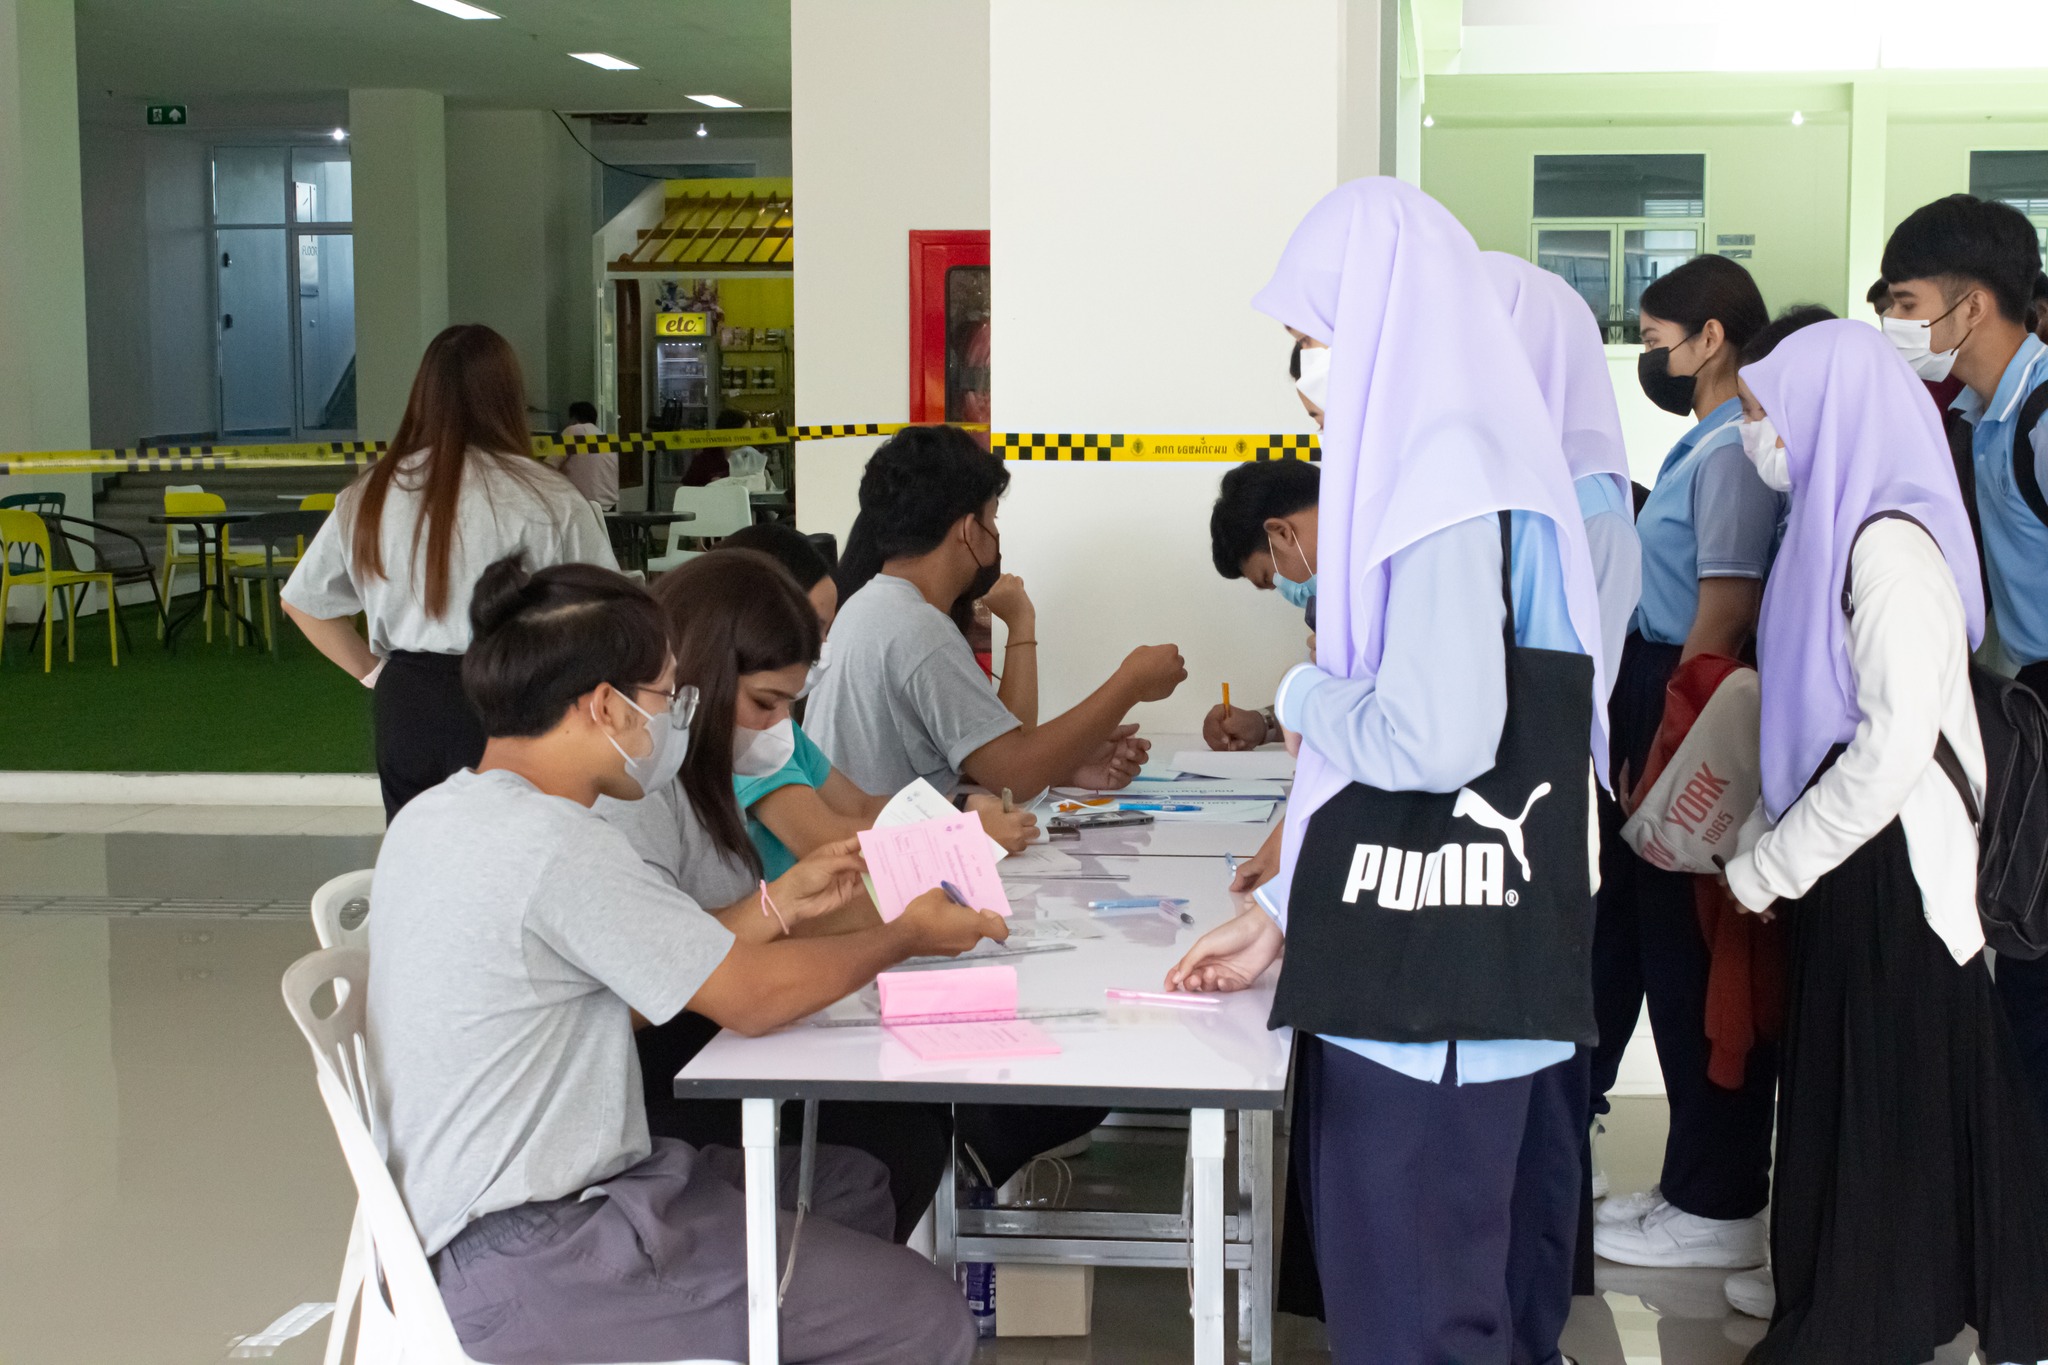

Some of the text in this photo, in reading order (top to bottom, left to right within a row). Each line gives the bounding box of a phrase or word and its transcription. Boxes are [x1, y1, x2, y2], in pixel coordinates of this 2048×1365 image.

[665, 316, 697, 333] etc.
[1665, 761, 1731, 835] YORK
[1701, 810, 1734, 845] 1965
[1342, 843, 1505, 911] PUMA
